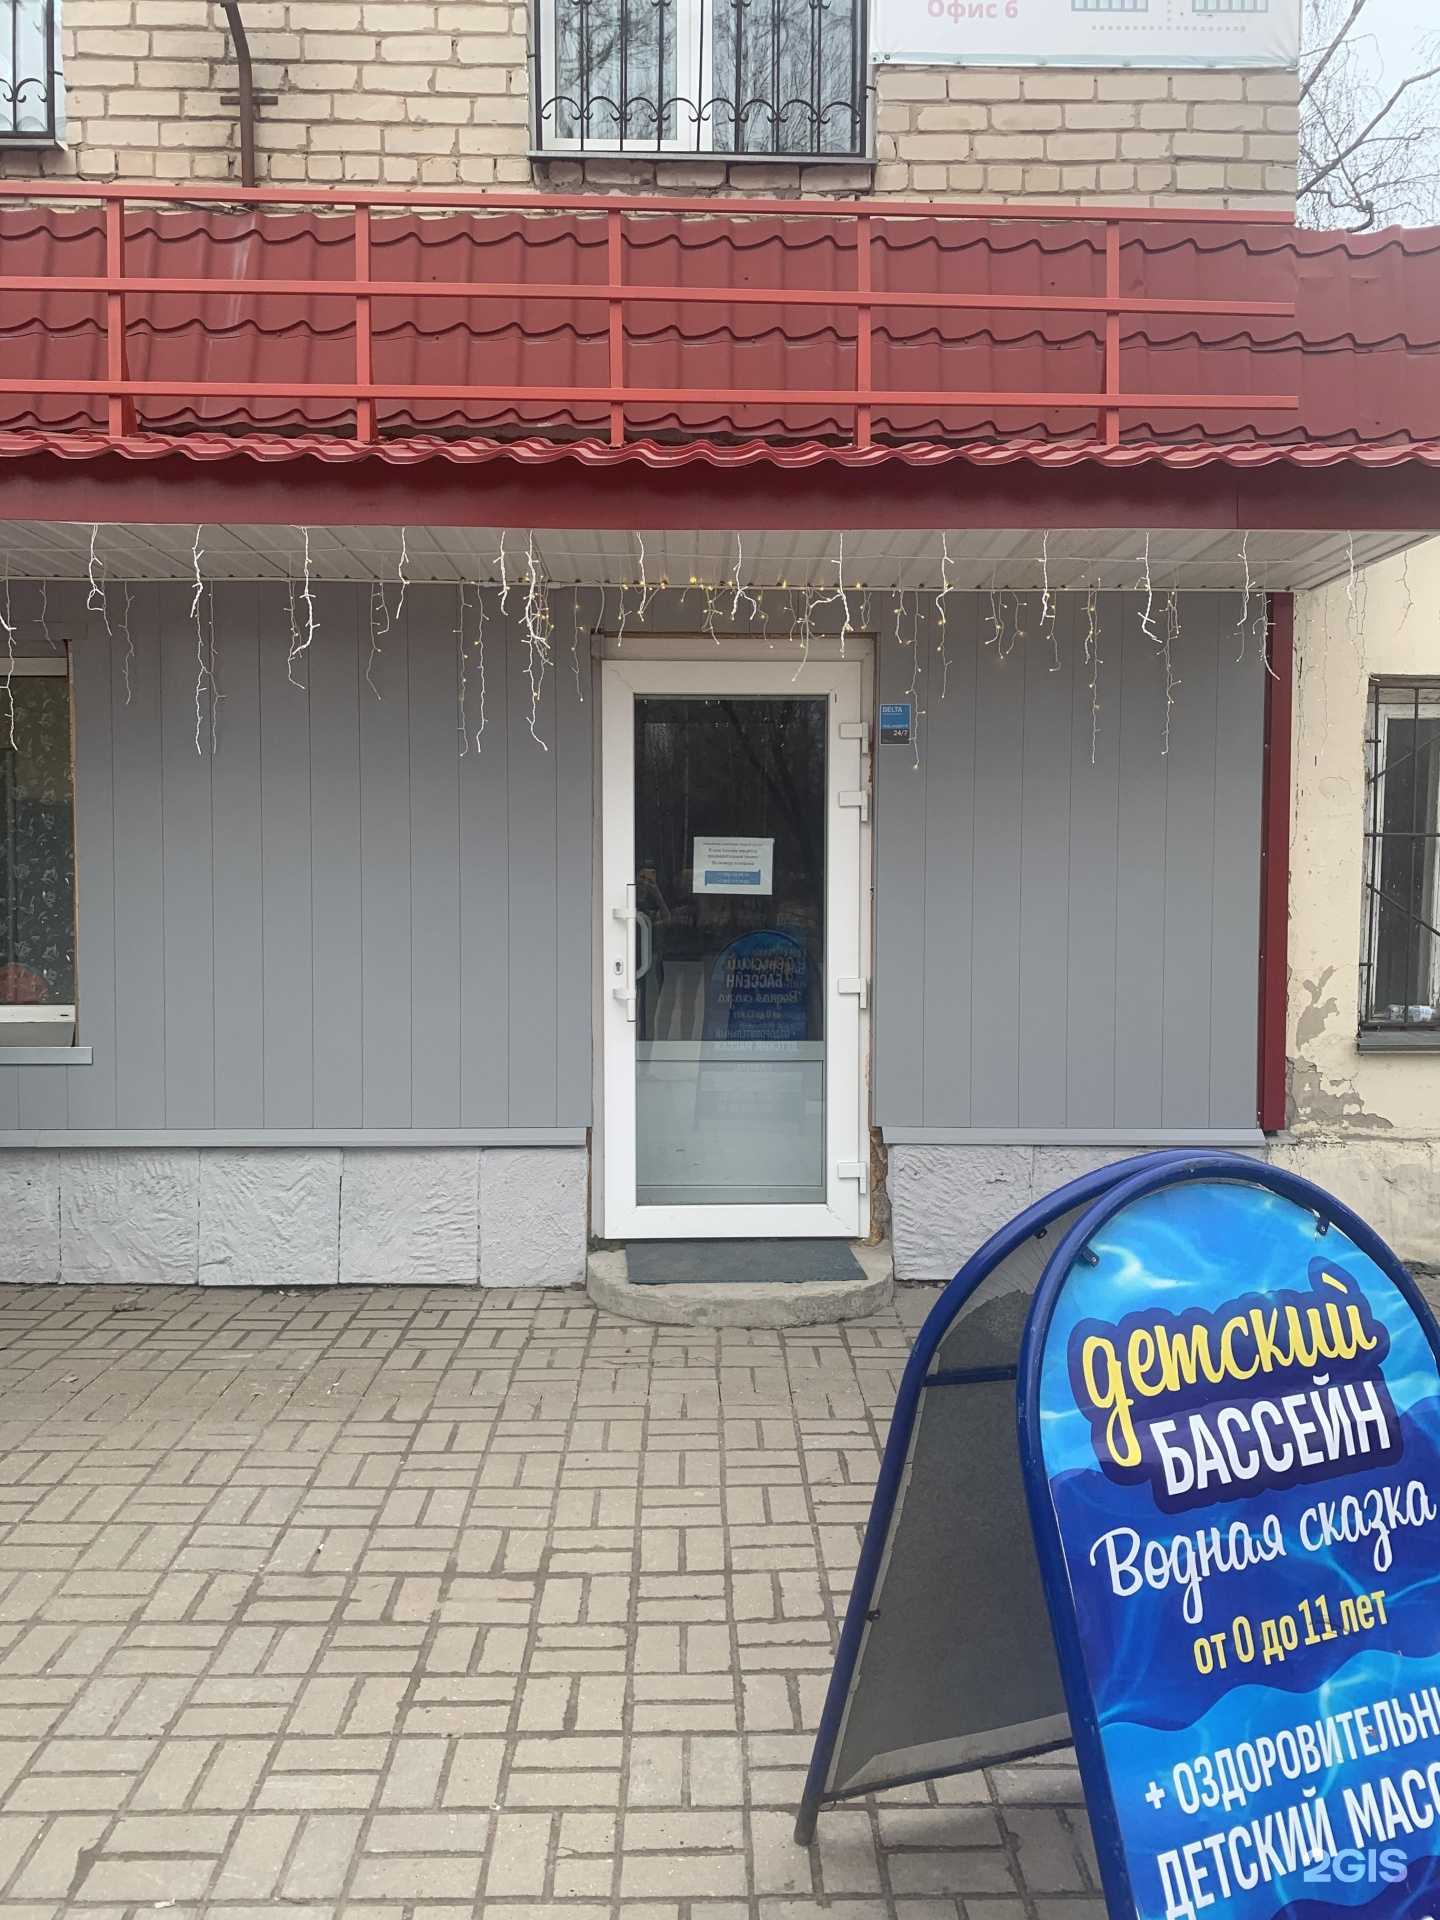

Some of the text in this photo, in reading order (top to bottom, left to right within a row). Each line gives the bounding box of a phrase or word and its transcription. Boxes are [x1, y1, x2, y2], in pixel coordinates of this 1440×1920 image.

[928, 0, 1018, 24] Офис 6
[1082, 1272, 1377, 1467] детский
[1150, 1373, 1390, 1496] БАССЕЙН
[1090, 1480, 1437, 1624] Водная сказка
[1193, 1590, 1388, 1674] от 0 до 11 лет
[1172, 1686, 1440, 1814] ОЗДОРОВИТЕЛЬН
[1156, 1786, 1338, 1920] ДЕТСКИЙ
